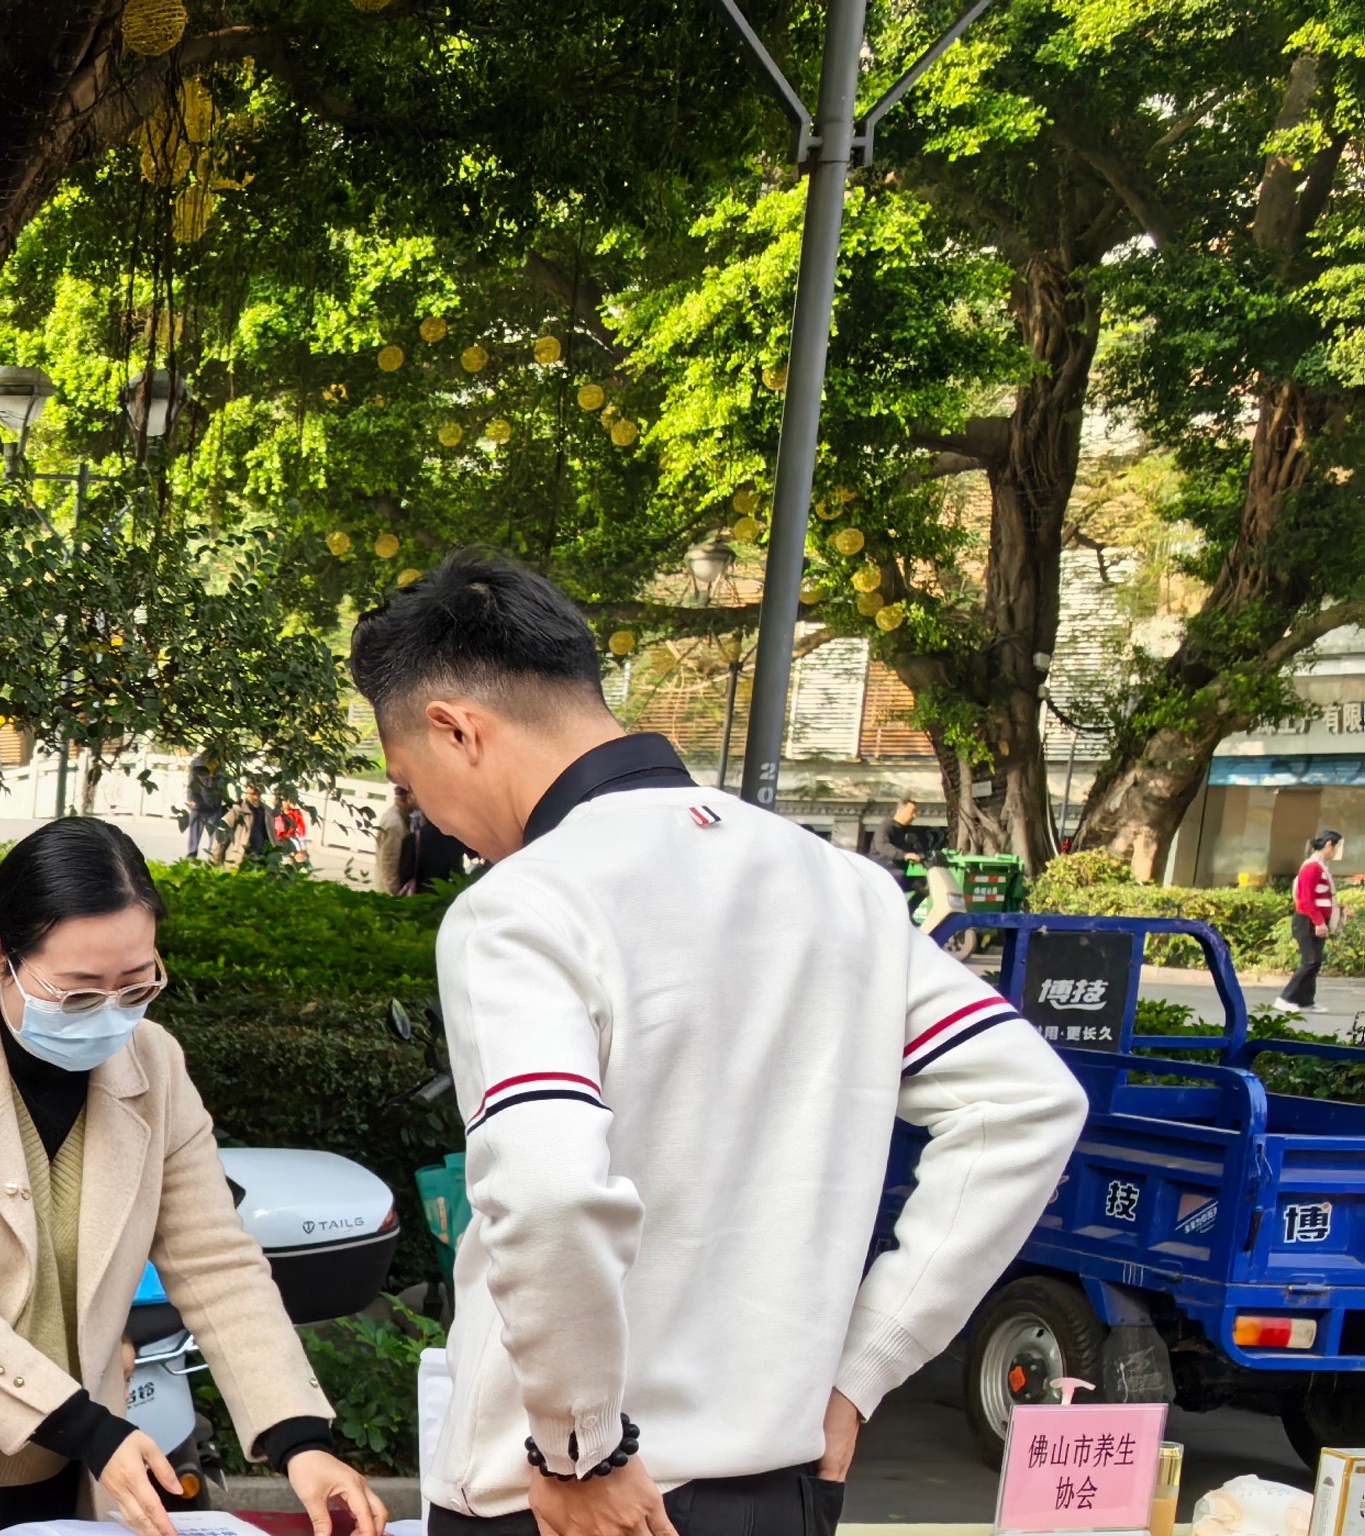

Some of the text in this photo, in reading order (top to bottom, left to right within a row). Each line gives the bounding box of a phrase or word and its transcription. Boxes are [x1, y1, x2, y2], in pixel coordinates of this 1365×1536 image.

[1037, 978, 1109, 1006] 博技
[1105, 1180, 1140, 1222] 技
[317, 1217, 365, 1231] TAILG
[1283, 1203, 1332, 1244] 博
[1028, 1432, 1137, 1469] 佛山市养生
[1055, 1475, 1098, 1510] 协会
